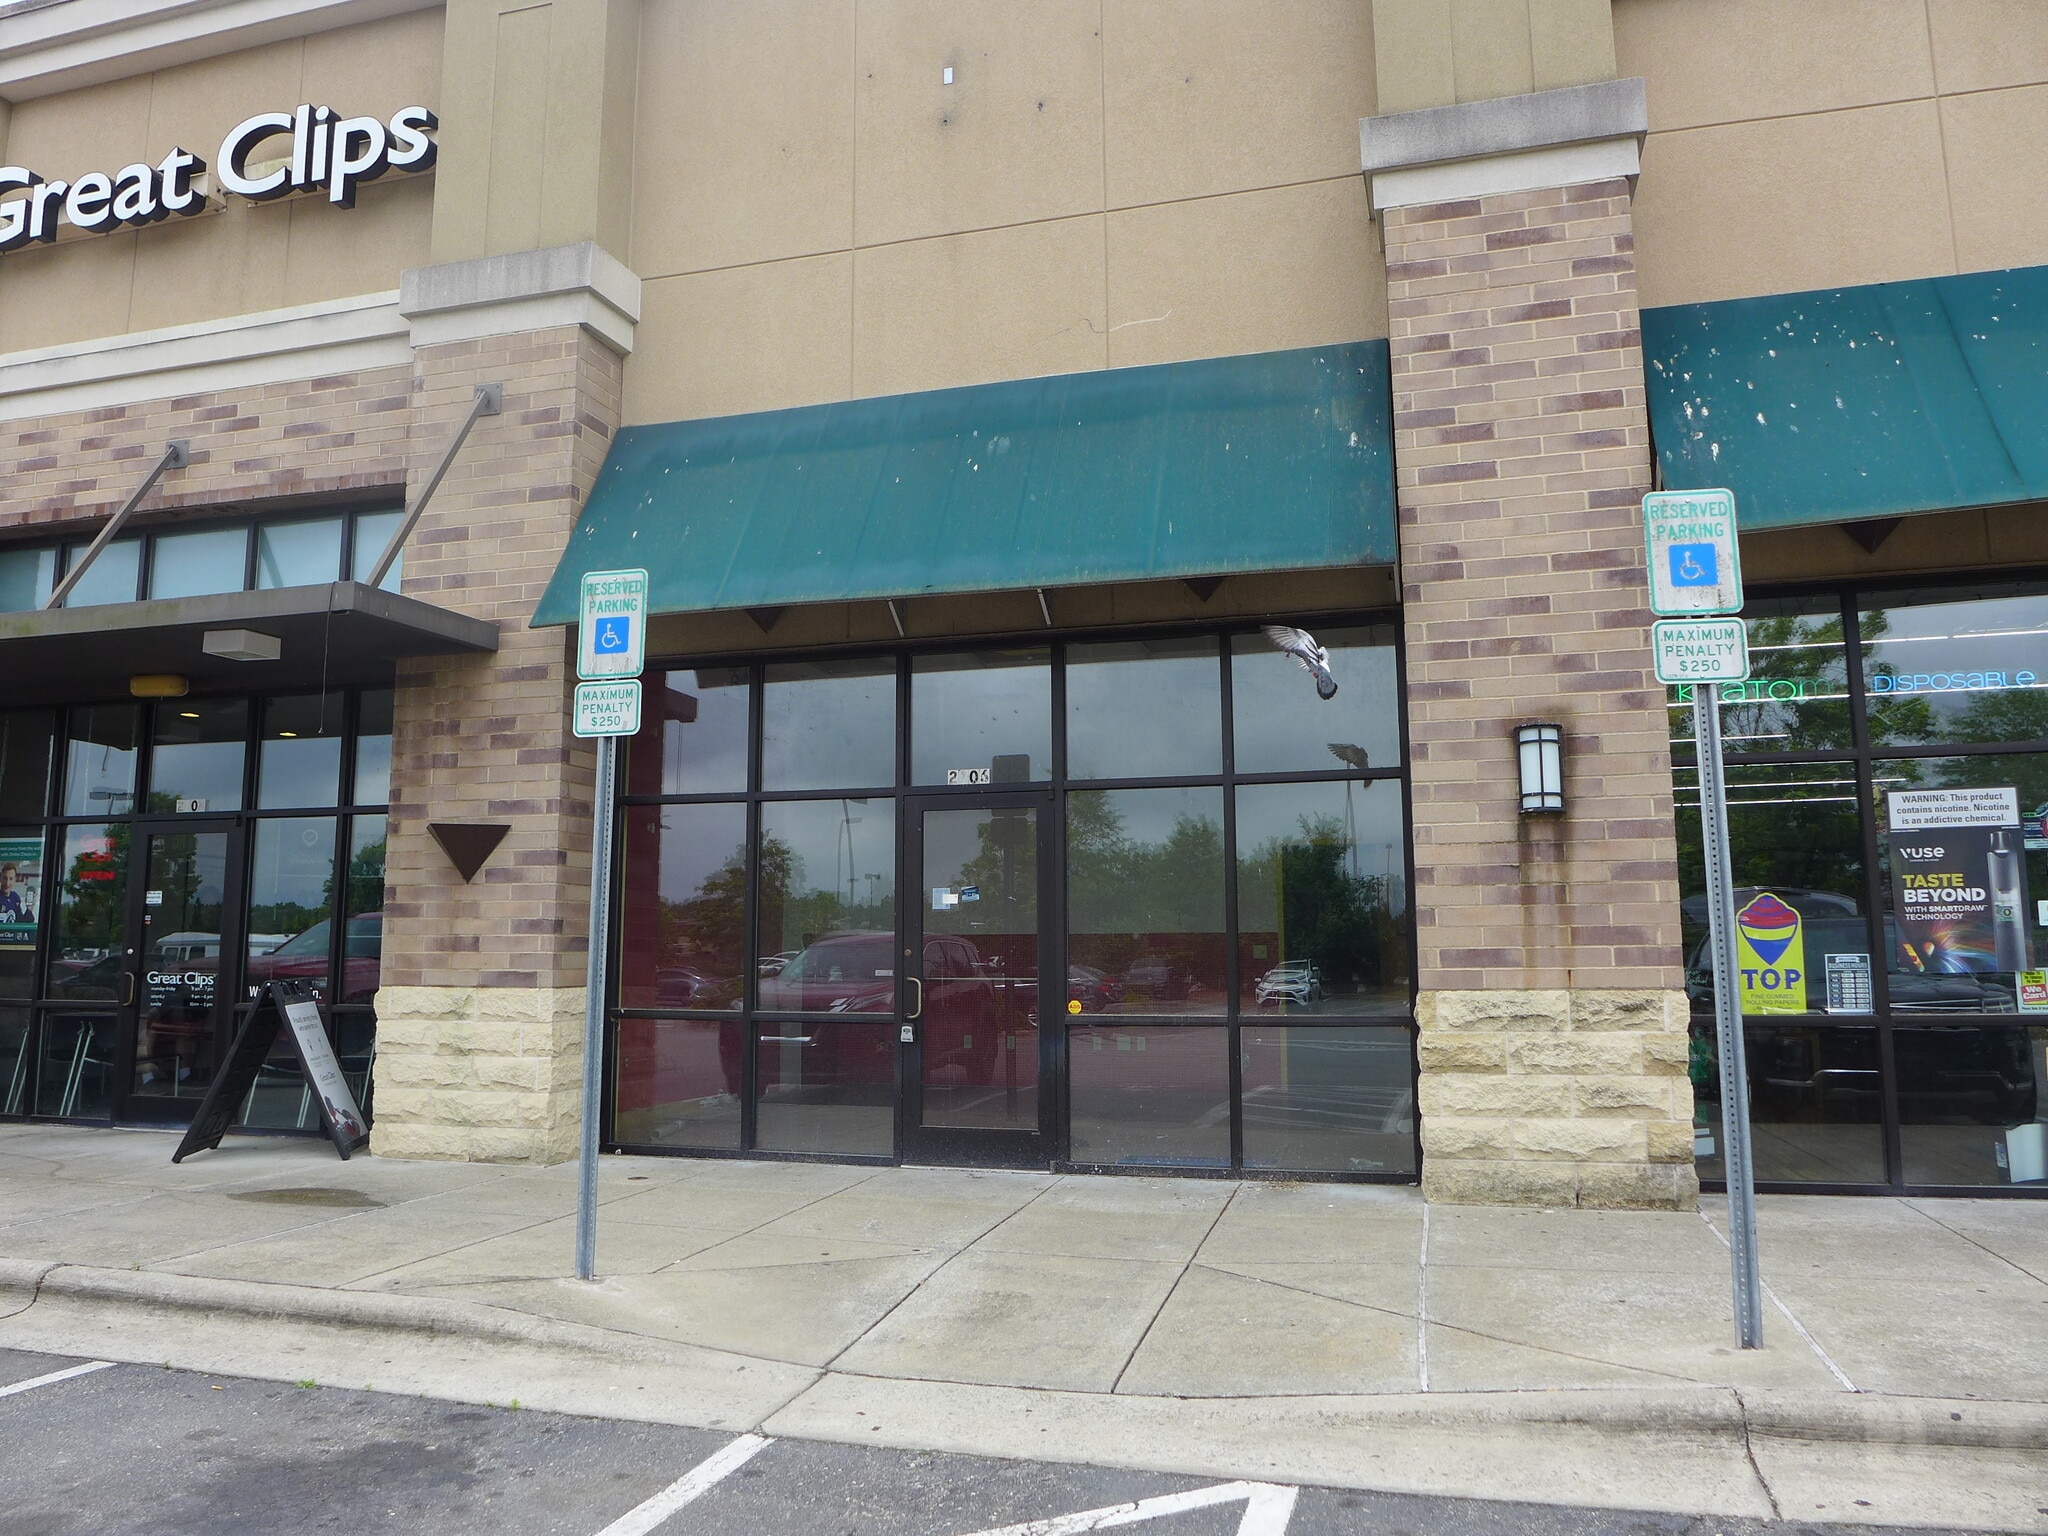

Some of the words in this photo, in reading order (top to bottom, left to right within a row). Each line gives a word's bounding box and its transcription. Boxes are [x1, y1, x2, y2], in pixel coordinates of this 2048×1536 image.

[0, 147, 200, 248] Great
[217, 103, 434, 206] Clips
[1650, 501, 1728, 519] RESERVED
[1656, 522, 1724, 540] PARKING
[586, 580, 643, 596] RESERVED
[589, 598, 638, 614] PARKING
[1664, 628, 1735, 642] MAXIMUM
[1665, 643, 1735, 657] PENALTY
[1680, 659, 1721, 672] $250
[582, 688, 634, 701] MAXIMUM
[582, 702, 633, 714] PENALTY
[591, 715, 621, 727] $250
[1901, 794, 1948, 804] WARNING:
[1950, 793, 1968, 802] This
[1970, 792, 2003, 802] product
[1897, 805, 1933, 815] contains
[1934, 804, 1971, 813] nicotine.
[1973, 803, 2010, 812] Nicotine
[1901, 817, 1909, 825] is
[1911, 817, 1921, 825] an
[1923, 815, 1963, 824] addictive
[1965, 813, 2006, 822] chemical.
[1902, 873, 1964, 888] TASTE
[1903, 888, 1986, 903] BEYOND
[1905, 913, 1963, 921] TECHNOLOGY
[147, 971, 182, 984] Great
[184, 972, 214, 988] Clips
[1740, 968, 1802, 990] TOP
[2022, 991, 2046, 999] Card
